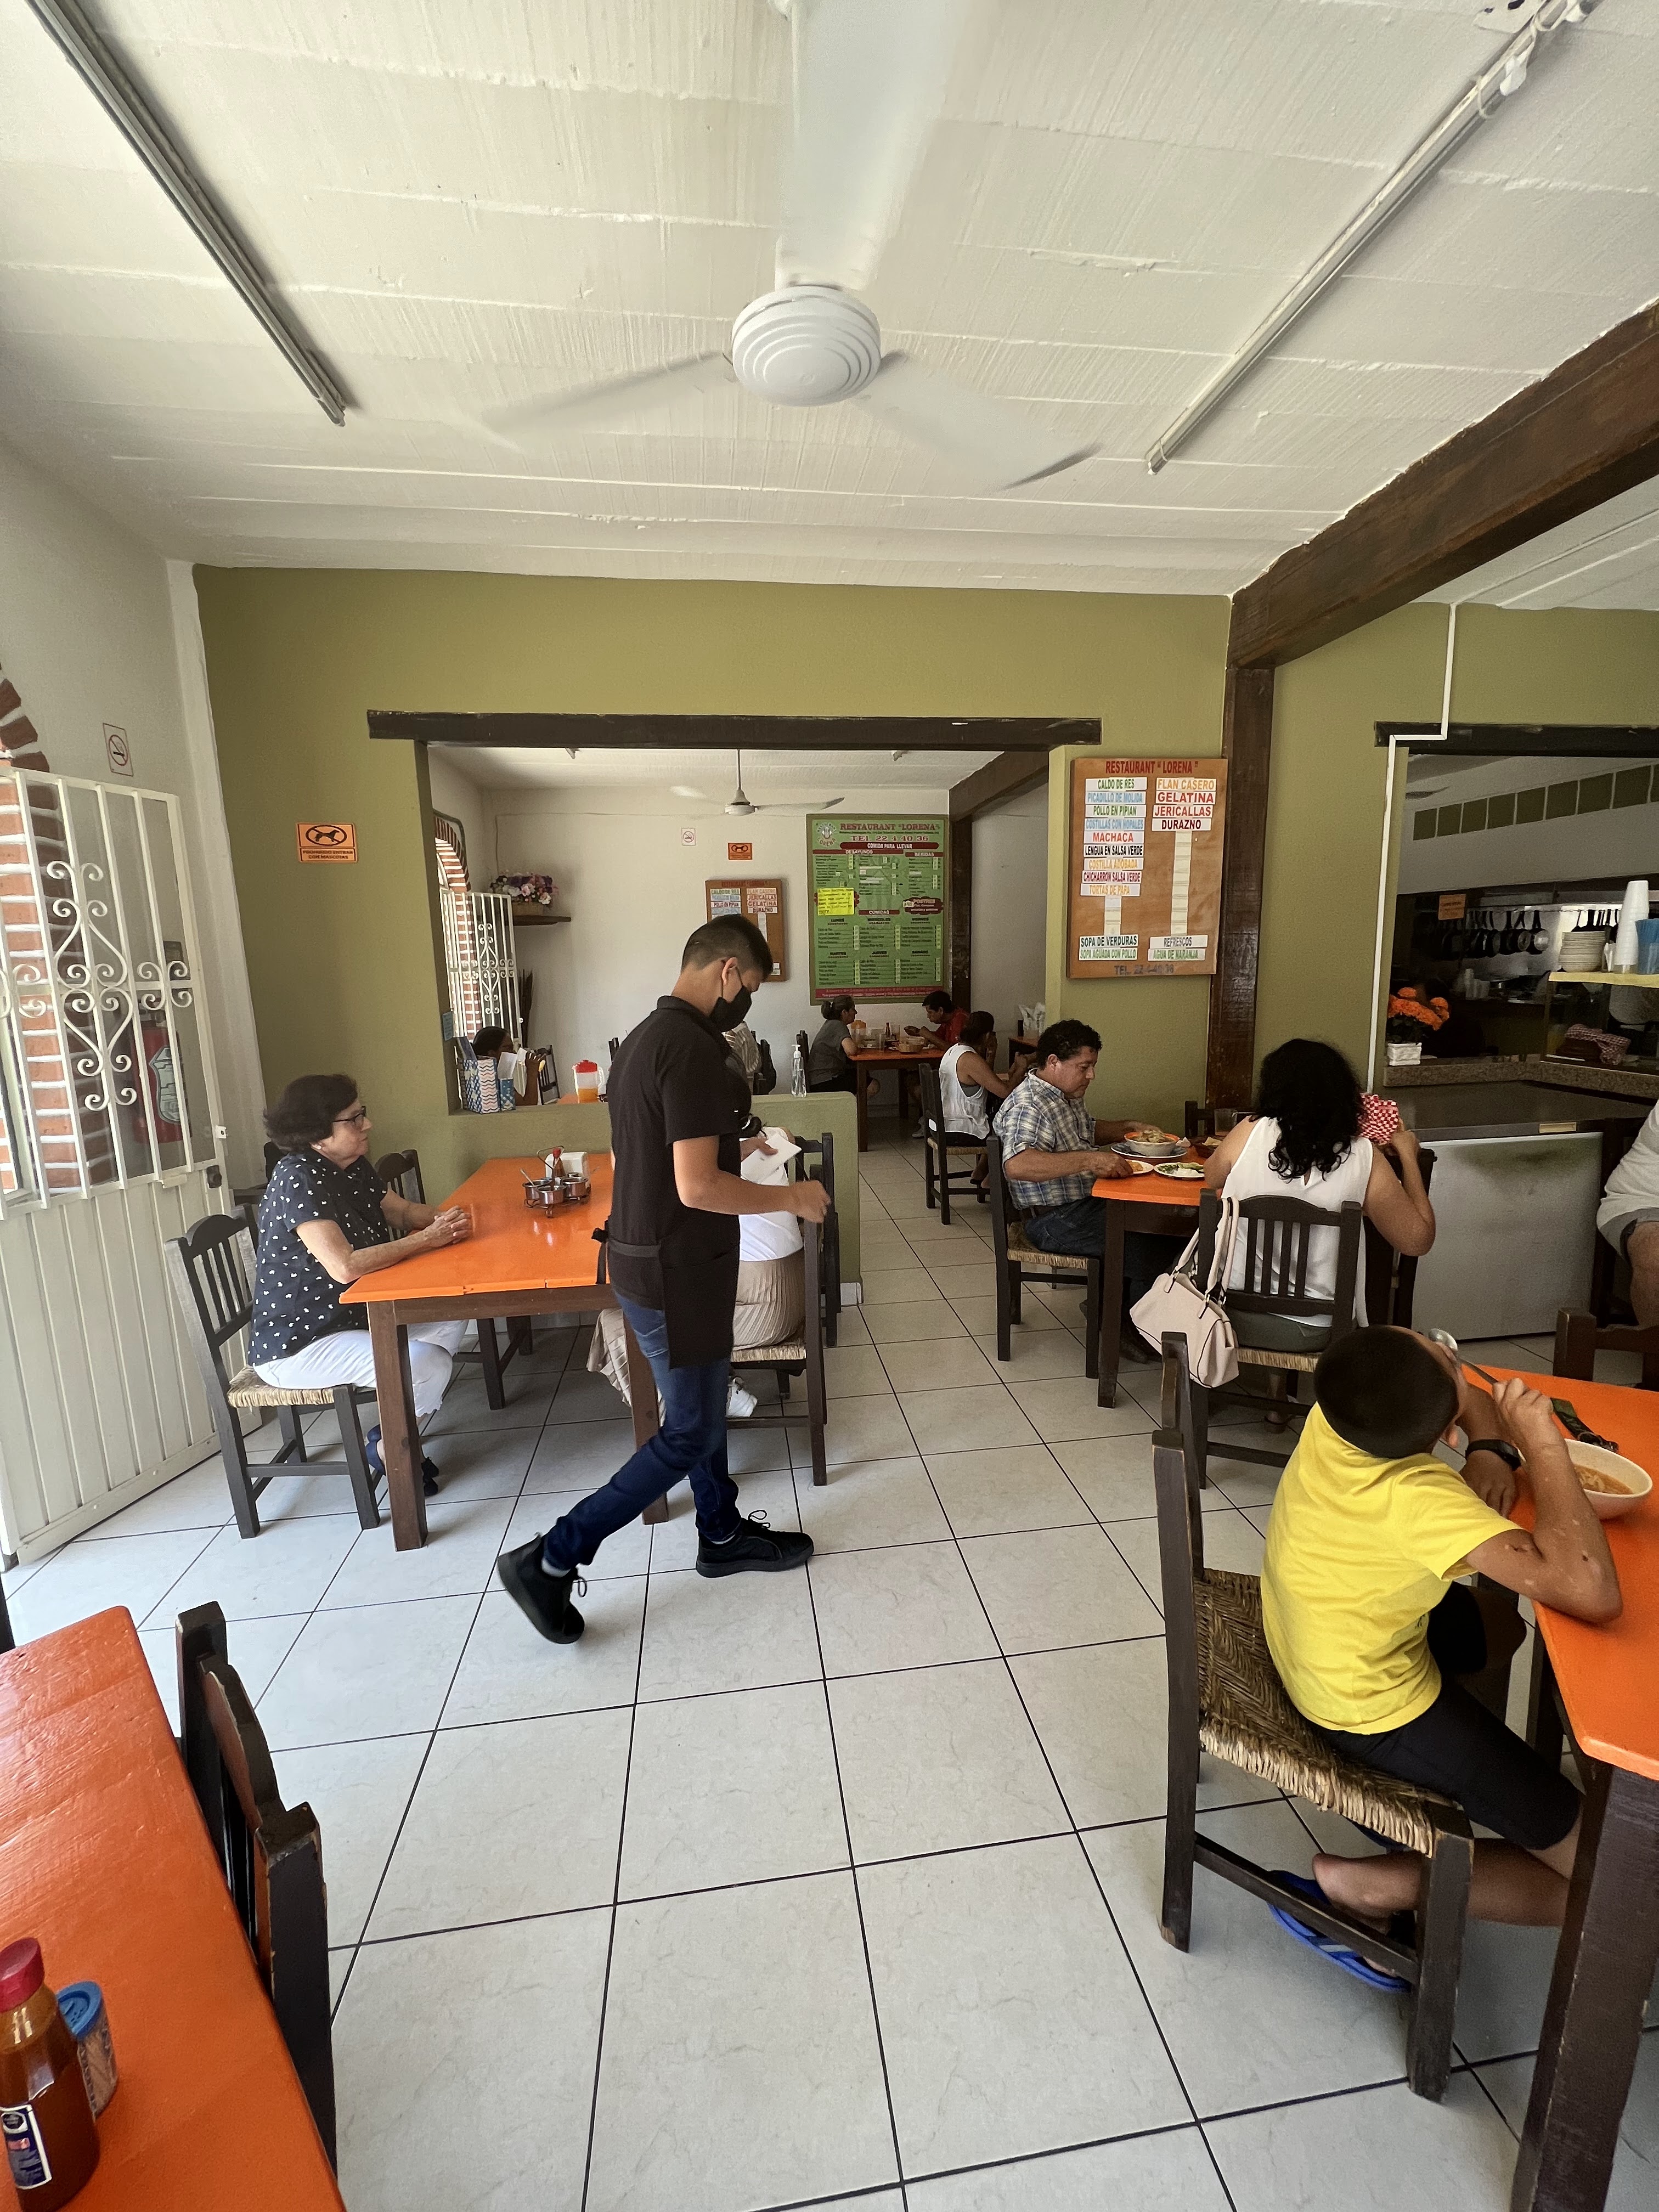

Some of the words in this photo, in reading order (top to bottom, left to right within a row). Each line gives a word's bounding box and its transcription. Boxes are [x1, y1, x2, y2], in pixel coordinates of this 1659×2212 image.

[1105, 760, 1155, 774] RESTAURANT
[1098, 779, 1115, 789] CALDO
[1116, 779, 1123, 789] DE
[1124, 778, 1135, 789] RES
[1158, 778, 1179, 789] FLAN
[1181, 779, 1215, 790] CASERO
[1115, 792, 1122, 803] DE
[1158, 792, 1214, 803] GELATINA
[1093, 805, 1110, 815] POLLO
[1111, 805, 1118, 816] EN
[1119, 805, 1137, 816] PIPIAN
[1154, 806, 1211, 816] JERICALLAS
[1161, 819, 1201, 830] DURAZNO
[1093, 832, 1134, 843] MACHACA
[1085, 845, 1104, 856] LENGUA
[1104, 845, 1111, 855] EN
[1112, 845, 1127, 856] SALSA
[1127, 845, 1143, 855] VERDE
[1088, 859, 1113, 870] COSTILLA
[1084, 872, 1111, 882] CHICHARRON
[1112, 872, 1126, 882] SALSA
[1126, 872, 1141, 882] VERDE
[1090, 885, 1109, 895] TORTAS
[1109, 885, 1117, 895] DE
[1081, 937, 1096, 947] SOPA
[1097, 936, 1105, 946] DE
[1106, 935, 1137, 946] VERDURAS
[1164, 936, 1192, 947] REFRESCOS
[1153, 950, 1167, 960] AGUA
[1167, 950, 1174, 960] DE
